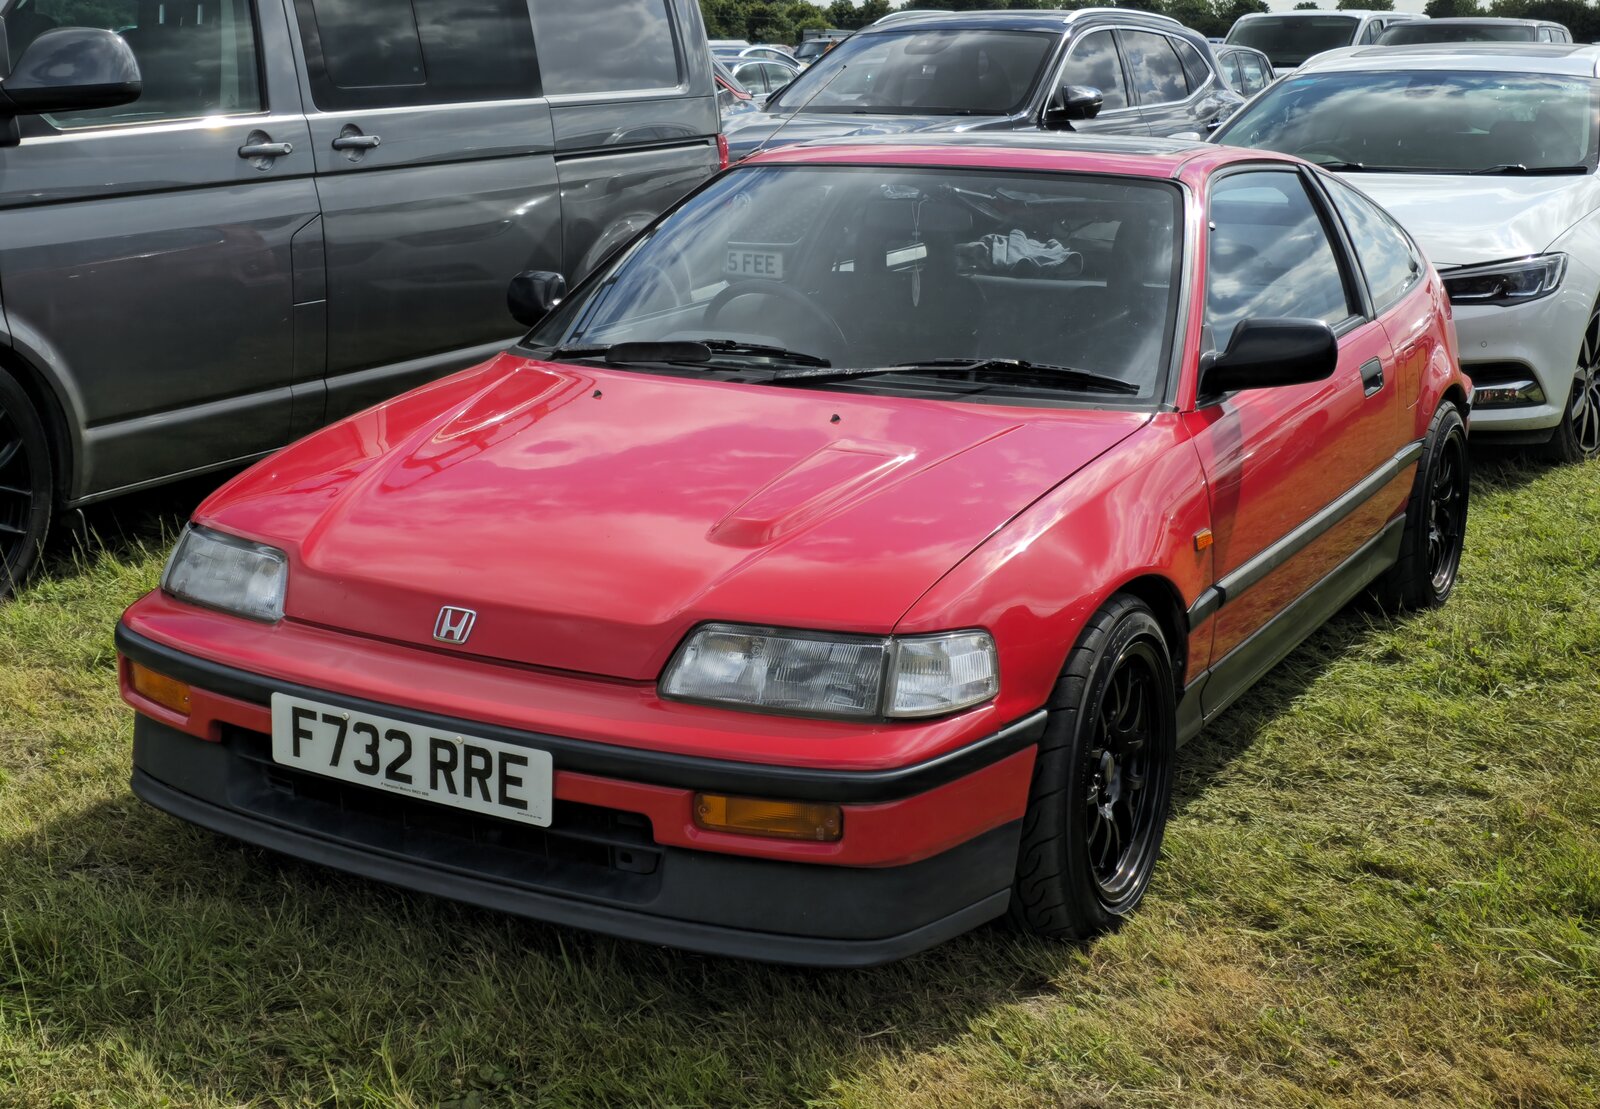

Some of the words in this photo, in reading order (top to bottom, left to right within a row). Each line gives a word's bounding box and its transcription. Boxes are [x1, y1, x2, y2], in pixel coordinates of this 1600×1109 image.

[742, 253, 776, 274] FEE
[291, 706, 413, 785] F732
[429, 737, 529, 811] RRE
